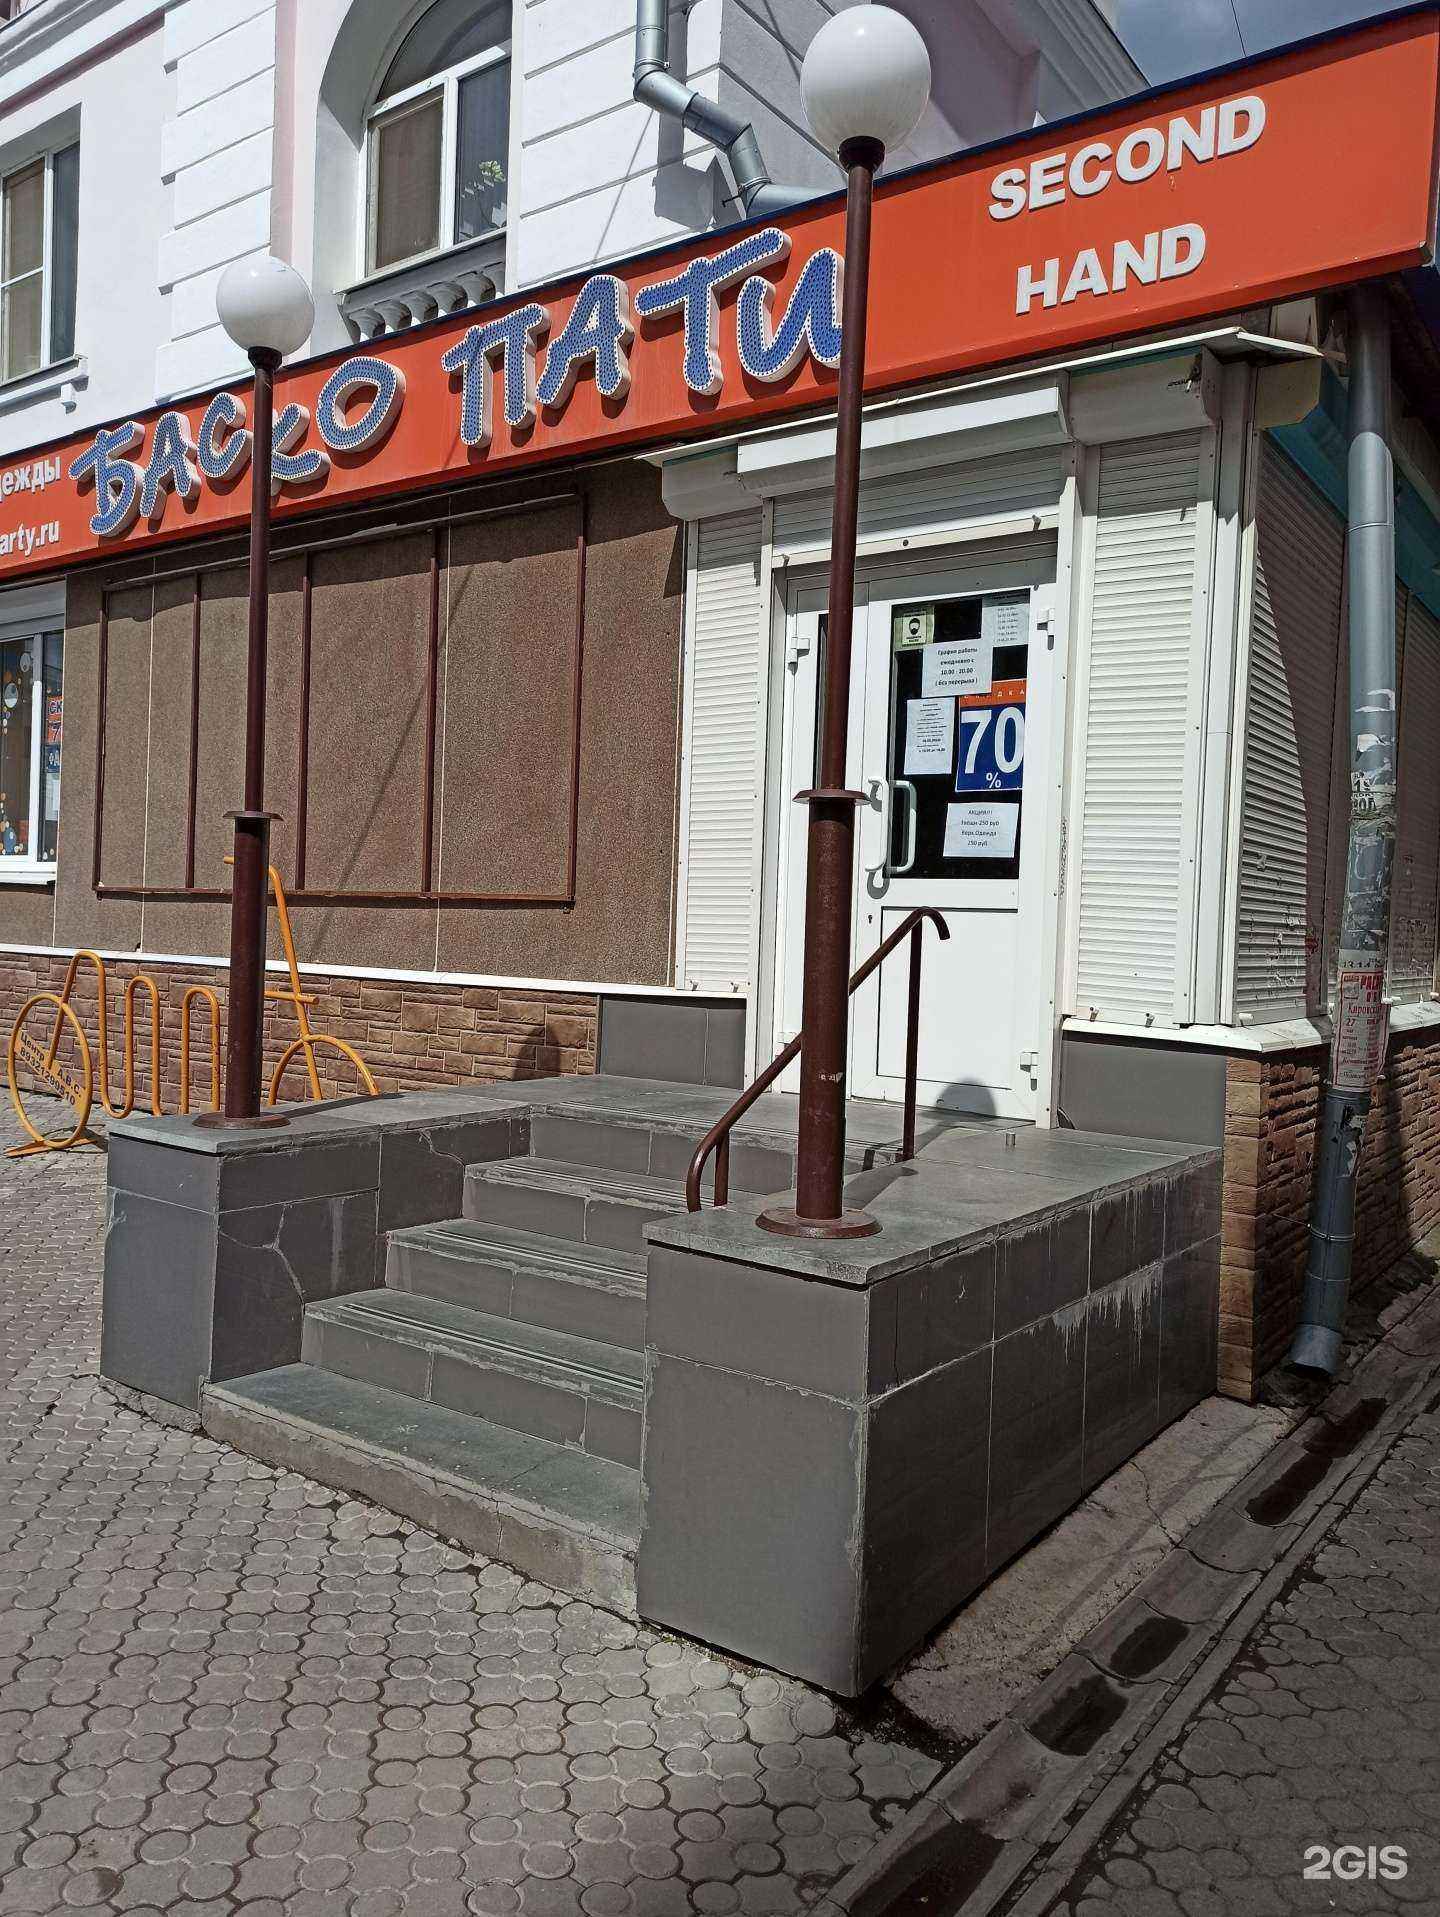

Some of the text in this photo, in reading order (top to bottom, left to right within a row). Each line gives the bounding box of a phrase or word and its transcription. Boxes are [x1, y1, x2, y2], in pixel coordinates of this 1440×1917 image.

[988, 95, 1266, 222] SECOND
[1015, 222, 1206, 316] HAND
[0, 456, 60, 503] ежды
[0, 521, 59, 557] arty.ru
[960, 706, 1025, 774] 70
[20, 1031, 45, 1061] Центр
